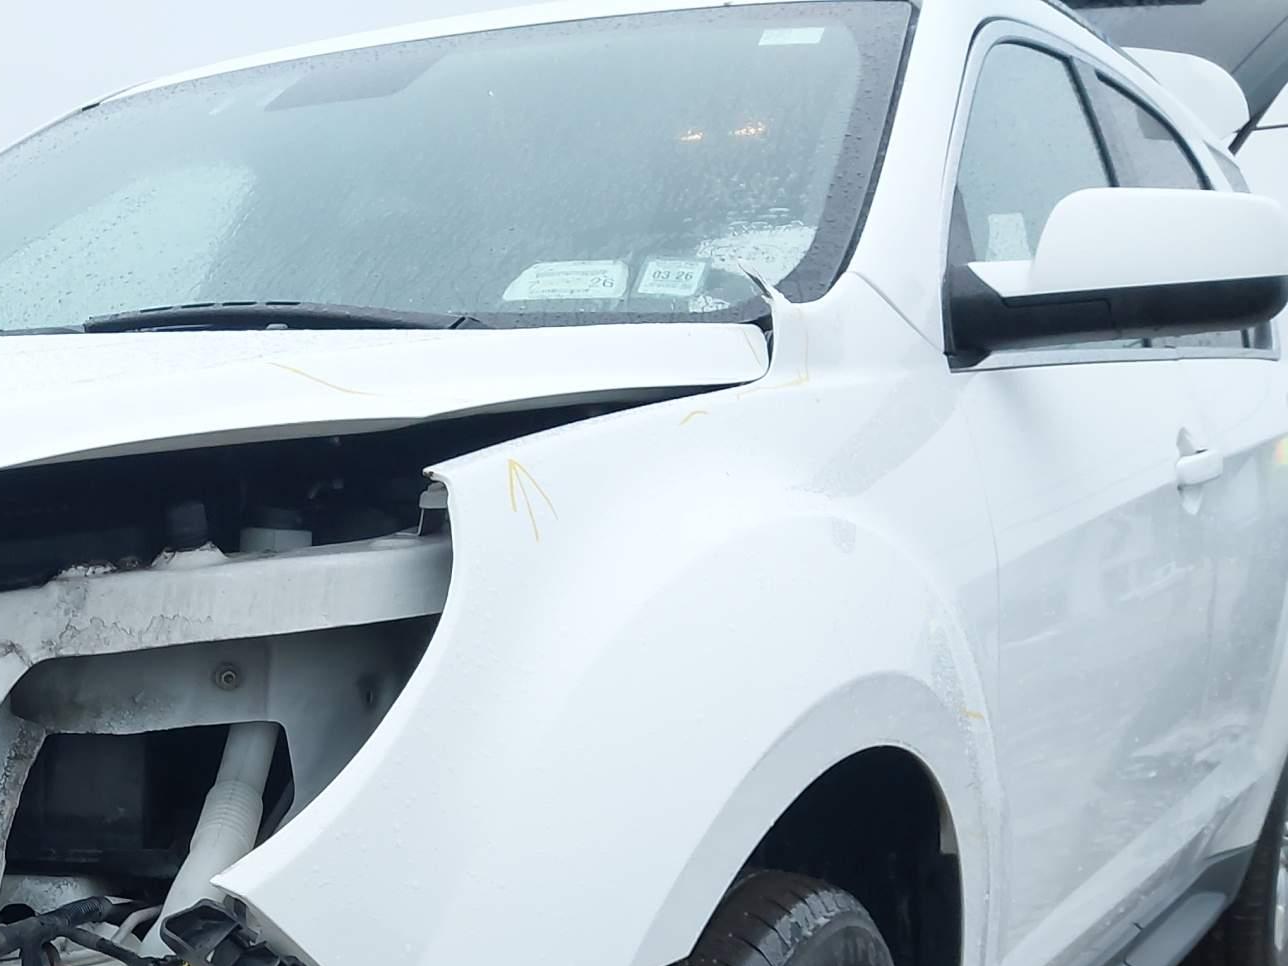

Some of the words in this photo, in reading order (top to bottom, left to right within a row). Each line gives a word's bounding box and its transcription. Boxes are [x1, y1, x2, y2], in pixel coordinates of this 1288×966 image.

[589, 275, 615, 288] 26
[652, 270, 671, 281] 03
[674, 270, 694, 281] 26
